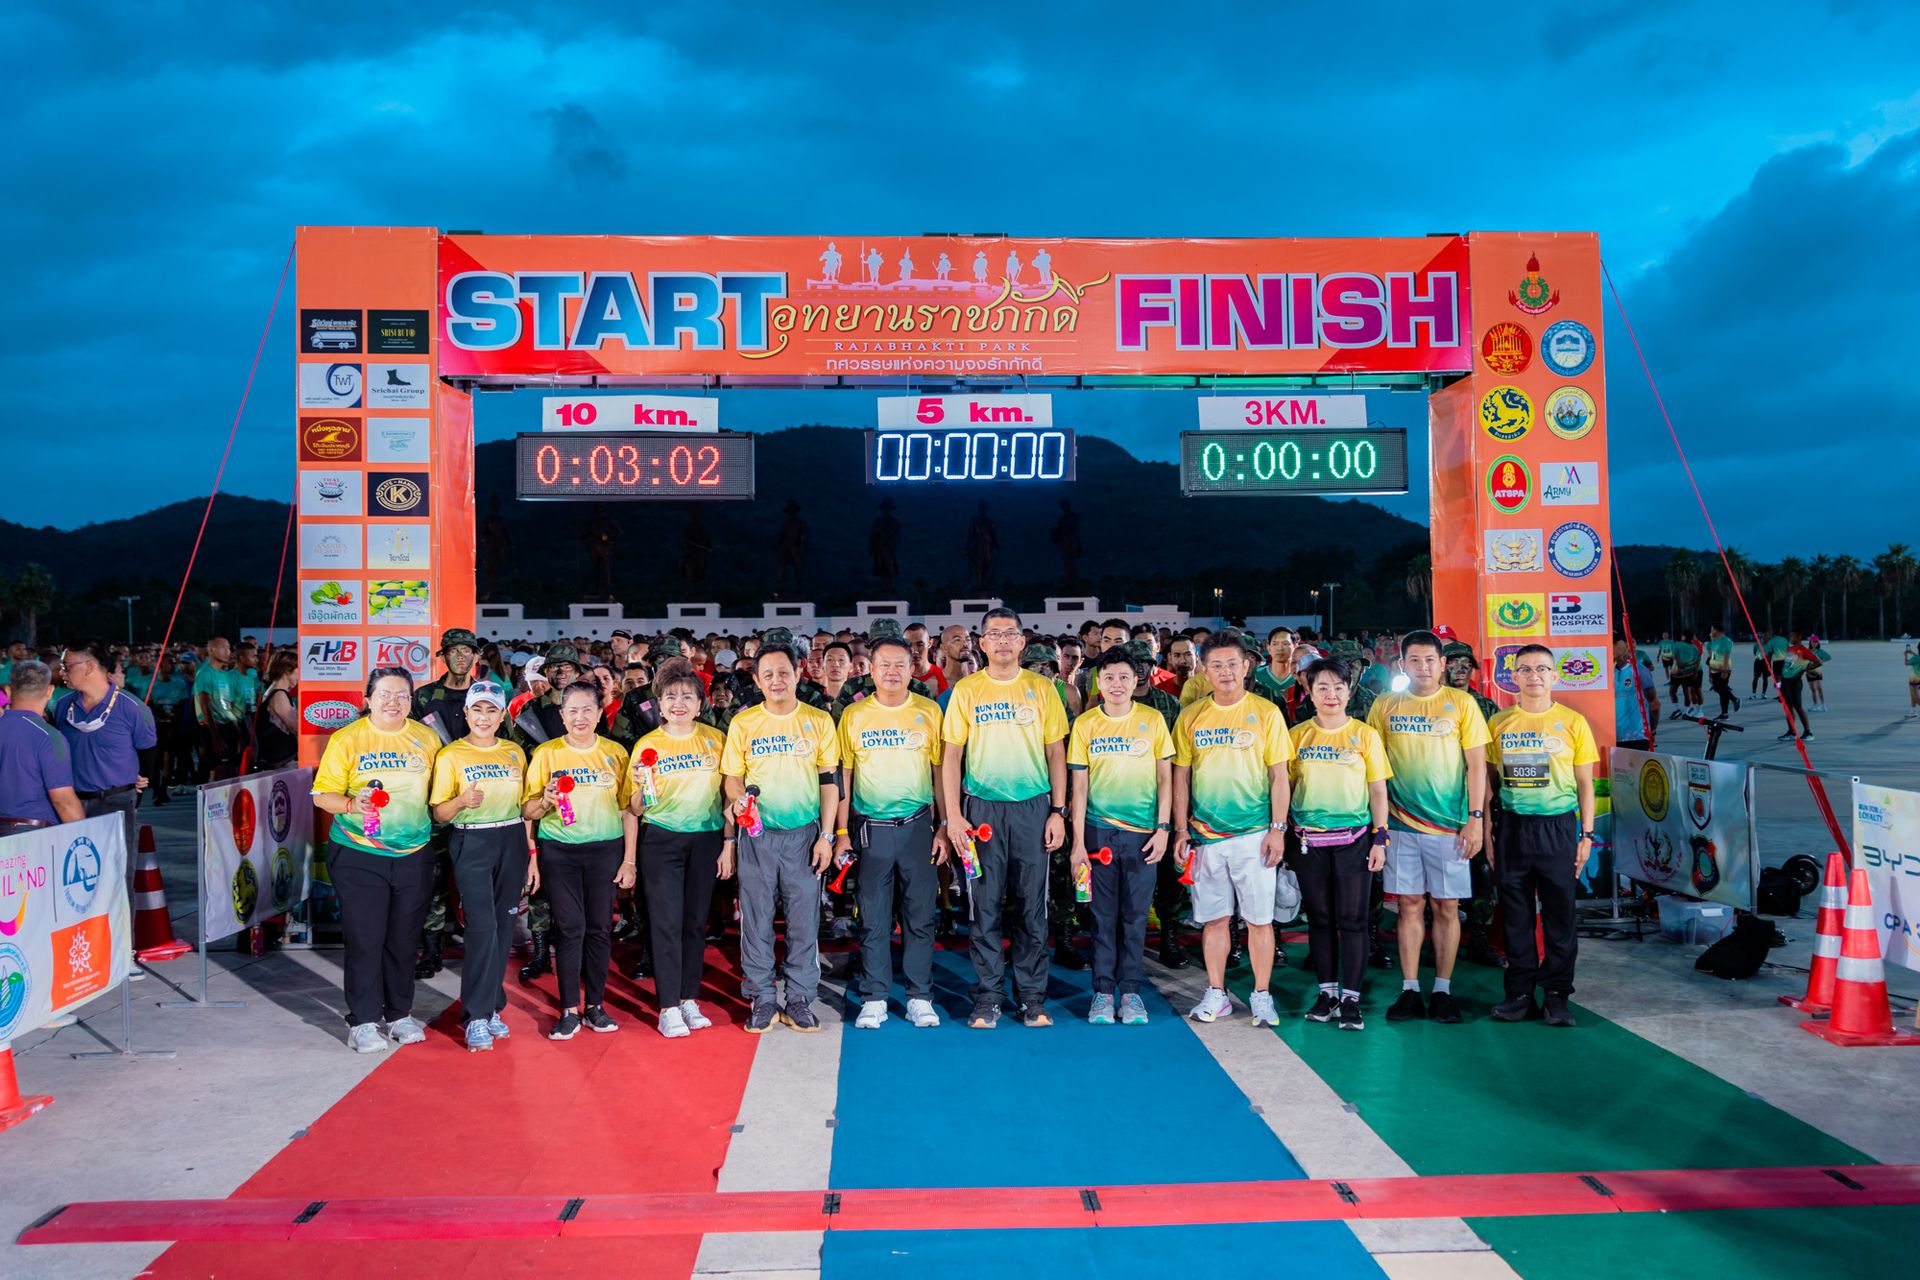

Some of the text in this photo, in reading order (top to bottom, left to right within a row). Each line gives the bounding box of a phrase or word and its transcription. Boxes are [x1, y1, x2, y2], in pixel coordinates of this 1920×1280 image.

[445, 271, 788, 351] START
[1115, 272, 1460, 351] FINISH
[834, 343, 1031, 352] RAJABHAKTI PARK
[826, 356, 1042, 371] ทศวรรษแห่งความจงรักภักดี
[400, 387, 425, 395] Group
[555, 403, 698, 426] 10 km.
[916, 398, 1033, 425] 5 km.
[1245, 400, 1326, 426] 3KM.
[876, 432, 1065, 481] 00:00:00
[1202, 440, 1376, 481] 0:00:00
[536, 445, 721, 485] 0:03:02
[314, 708, 350, 720] SUPER
[975, 704, 992, 713] RUN
[976, 711, 1016, 723] LOYALTY
[1194, 729, 1212, 737] RUN
[1390, 723, 1433, 732] LOYALTY
[861, 731, 879, 739] RUN
[751, 737, 768, 746] RUN
[863, 737, 906, 748] LOYALTY
[1090, 737, 1105, 745] RUN
[1195, 736, 1235, 747] LOYALTY
[1501, 739, 1543, 749] LOYALTY
[751, 744, 794, 755] LOYALTY
[1090, 744, 1130, 754] LOYALTY
[464, 765, 483, 774] RUN
[659, 760, 702, 774] LOYALTY
[1513, 767, 1537, 777] 5036
[467, 770, 509, 782] LOYALTY
[574, 775, 598, 783] ALTY
[3, 866, 47, 896] ILAND
